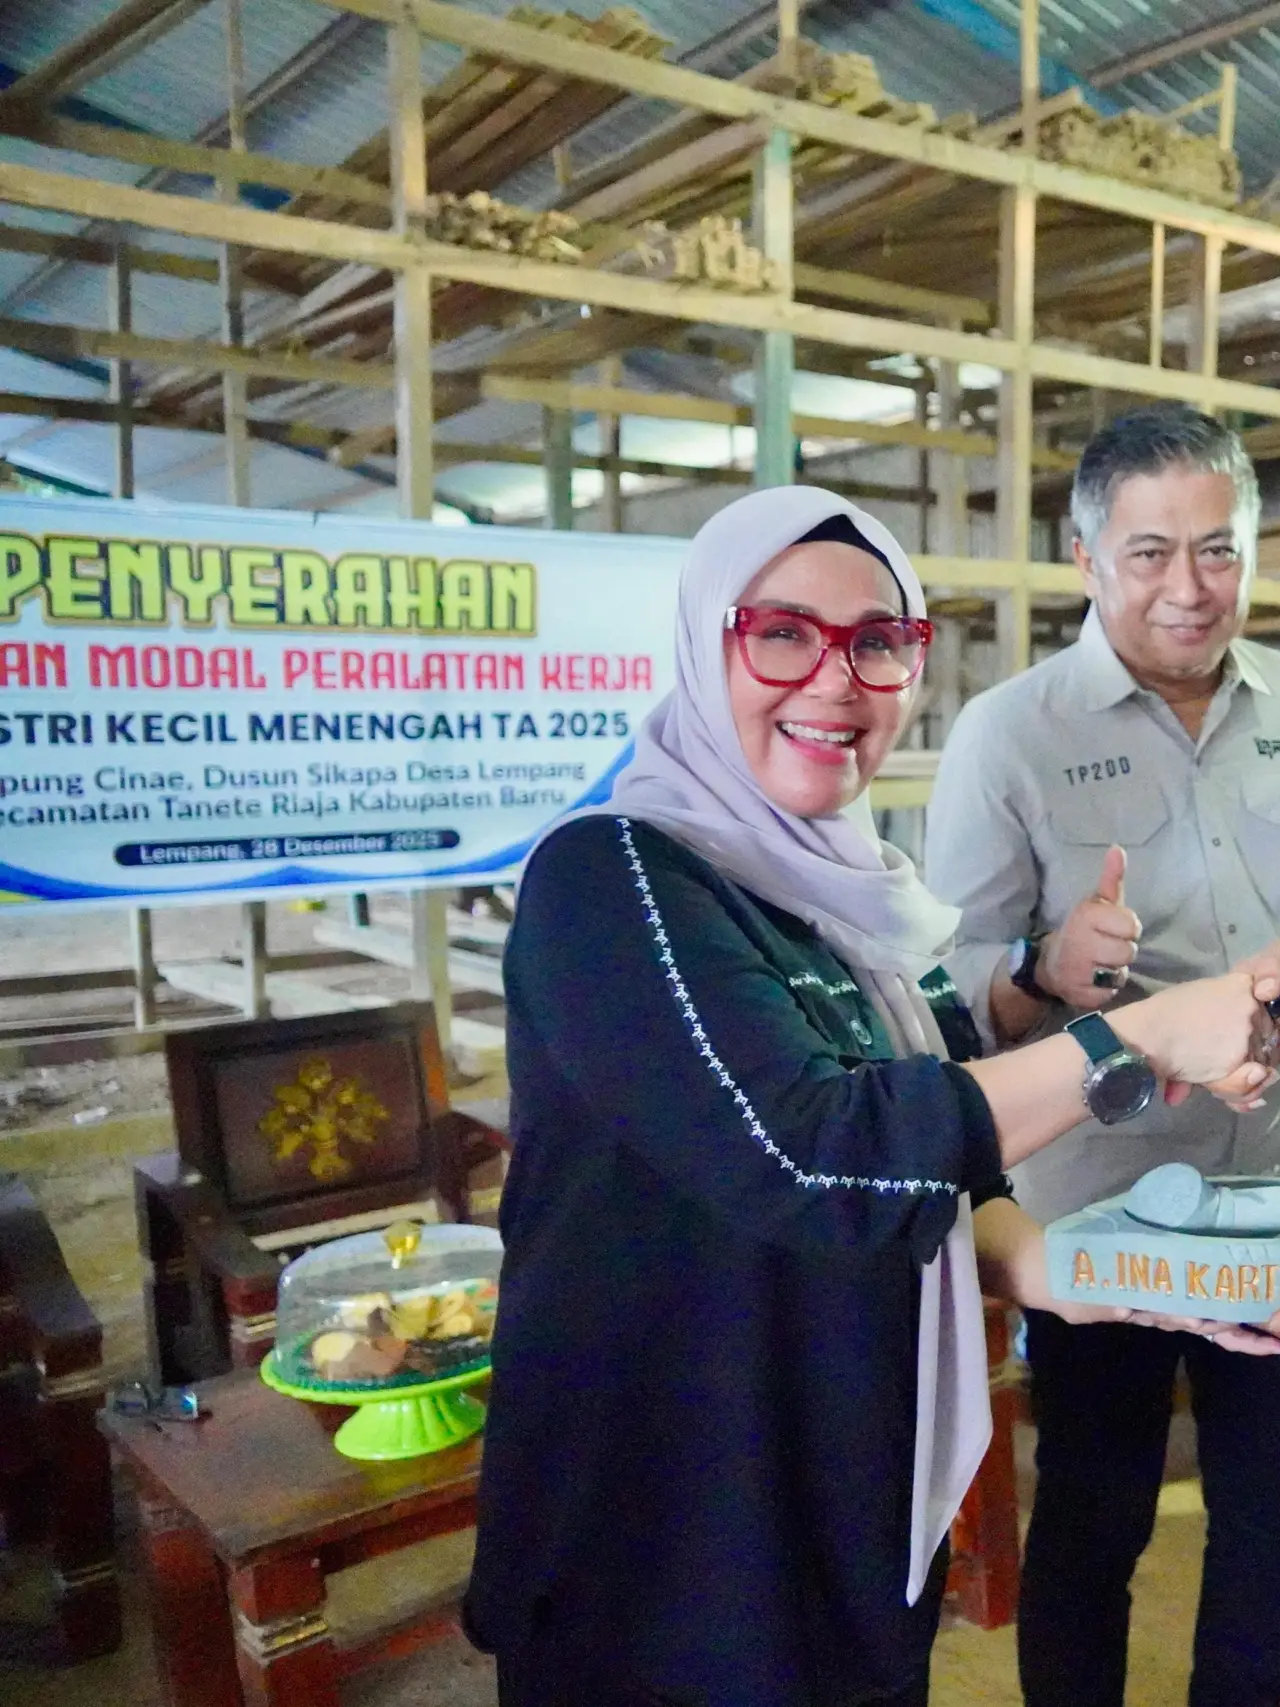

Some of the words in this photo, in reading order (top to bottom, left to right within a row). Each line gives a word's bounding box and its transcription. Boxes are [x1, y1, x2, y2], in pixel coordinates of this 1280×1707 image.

[0, 531, 538, 638] PENYERAHAN
[89, 644, 267, 688] MODAL
[283, 650, 524, 690] PERALATAN
[540, 653, 652, 691] KERJA
[106, 711, 237, 743] KECIL
[249, 711, 482, 742] MENENGAH
[492, 713, 538, 738] TA
[549, 711, 629, 738] 2025
[94, 766, 194, 792] Cinae,
[203, 764, 298, 789] Dusun
[307, 761, 396, 786] Sikapa
[406, 760, 470, 782] Desa
[478, 760, 585, 781] Lempang
[160, 795, 261, 820] Tanete
[272, 791, 339, 819] Riaja
[350, 787, 490, 814] Kabupaten
[499, 785, 565, 806] Barru
[284, 836, 386, 857] Desember
